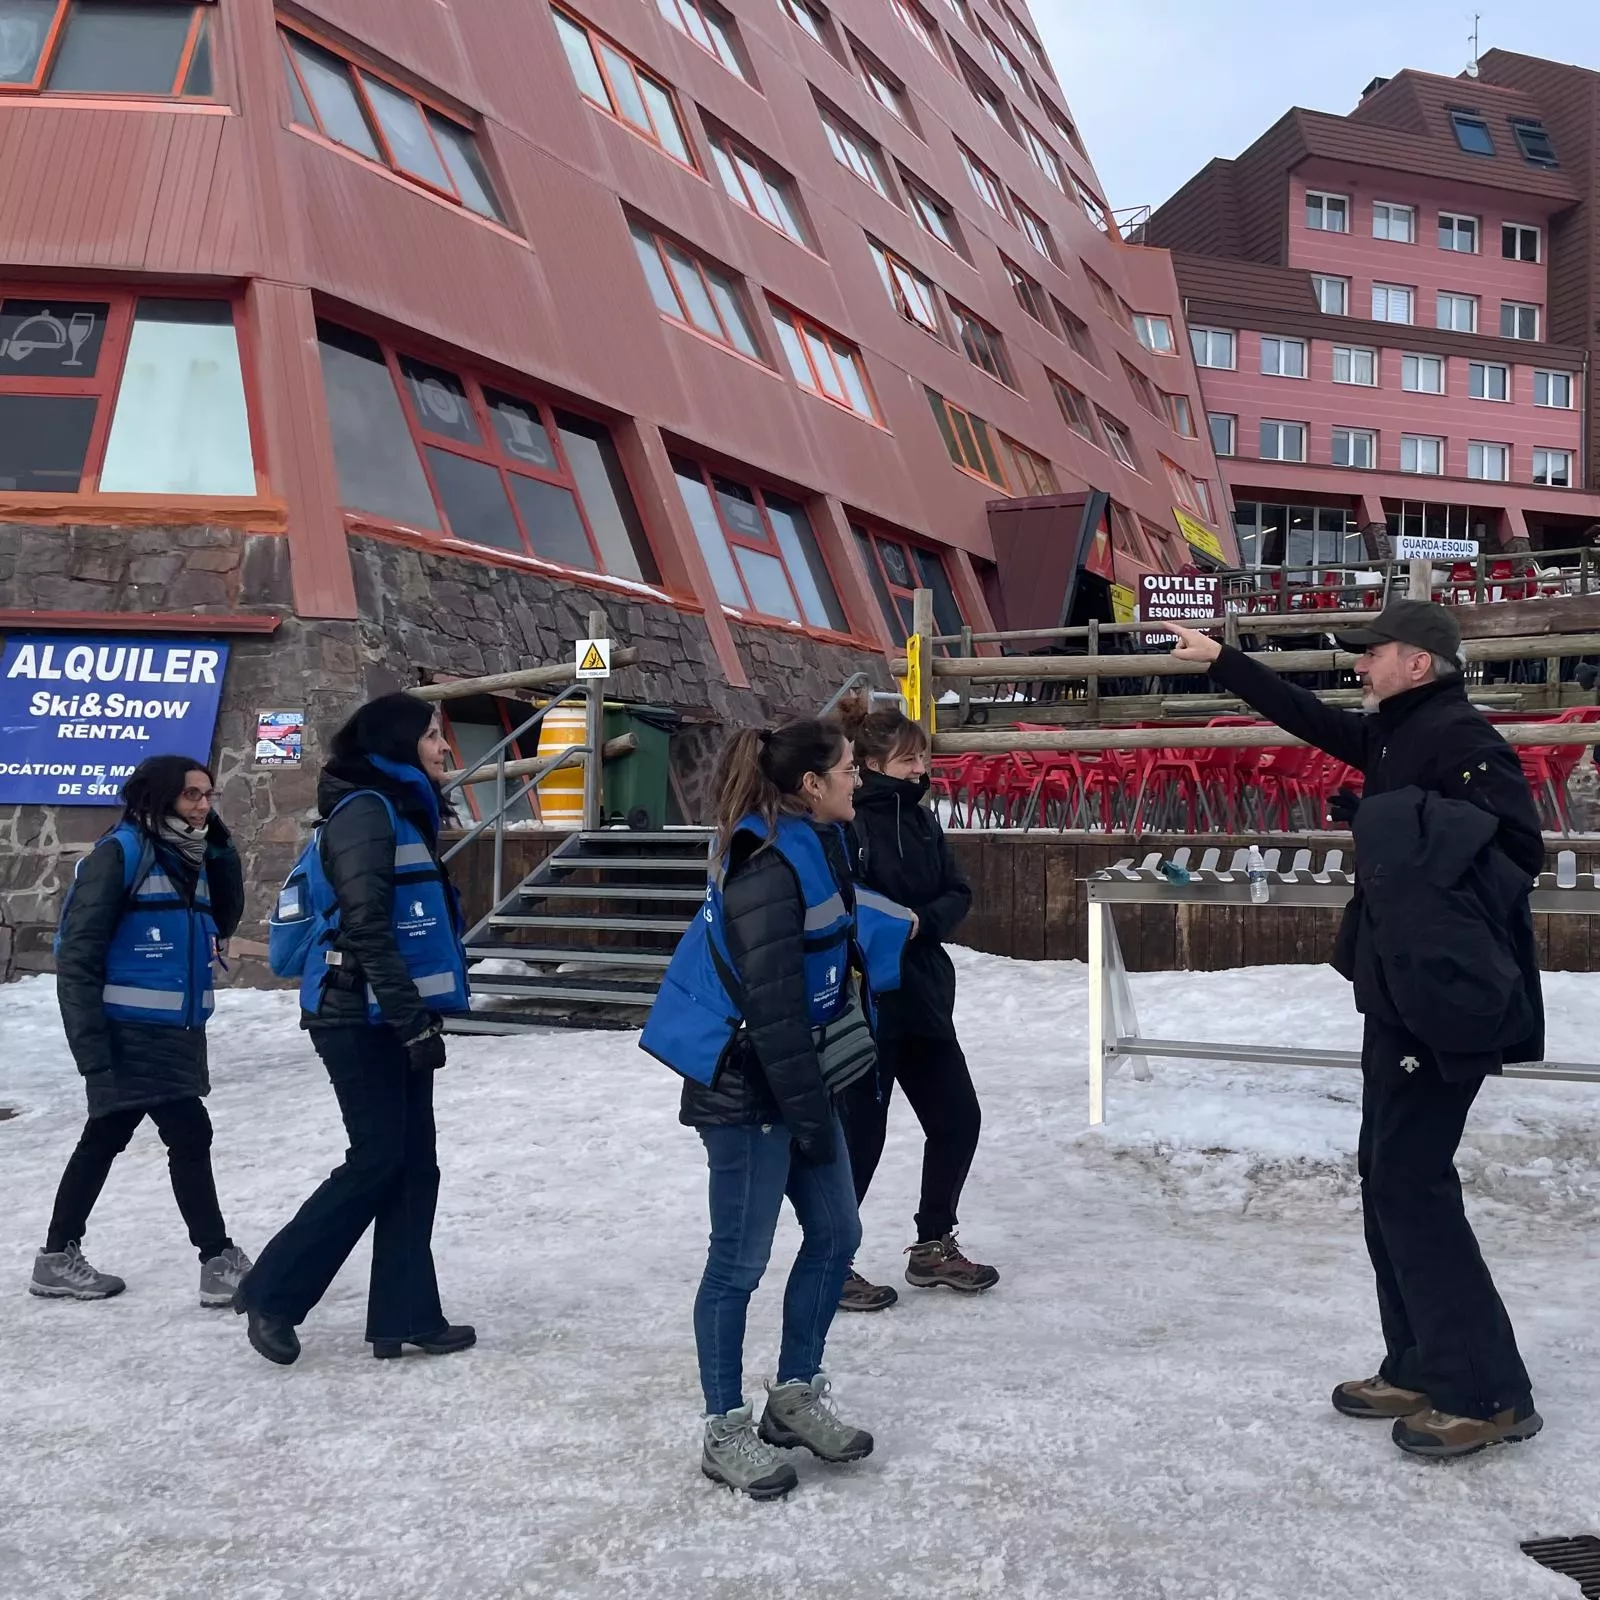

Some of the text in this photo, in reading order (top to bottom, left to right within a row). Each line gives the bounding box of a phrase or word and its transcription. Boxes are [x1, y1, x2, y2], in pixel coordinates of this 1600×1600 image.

[1402, 538, 1474, 553] GUARDA-ESQUIS
[1404, 550, 1472, 560] LAS MARM
[1143, 575, 1218, 591] OUTLET
[1150, 592, 1213, 605] ALQUILER
[1148, 607, 1215, 618] ESQUI-SNOW
[1145, 633, 1181, 645] GUARD
[7, 644, 219, 684] ALQUILER
[29, 691, 190, 719] Ski&Snow
[57, 723, 150, 740] RENTAL
[81, 765, 105, 776] DE
[58, 783, 118, 796] DE SKI
